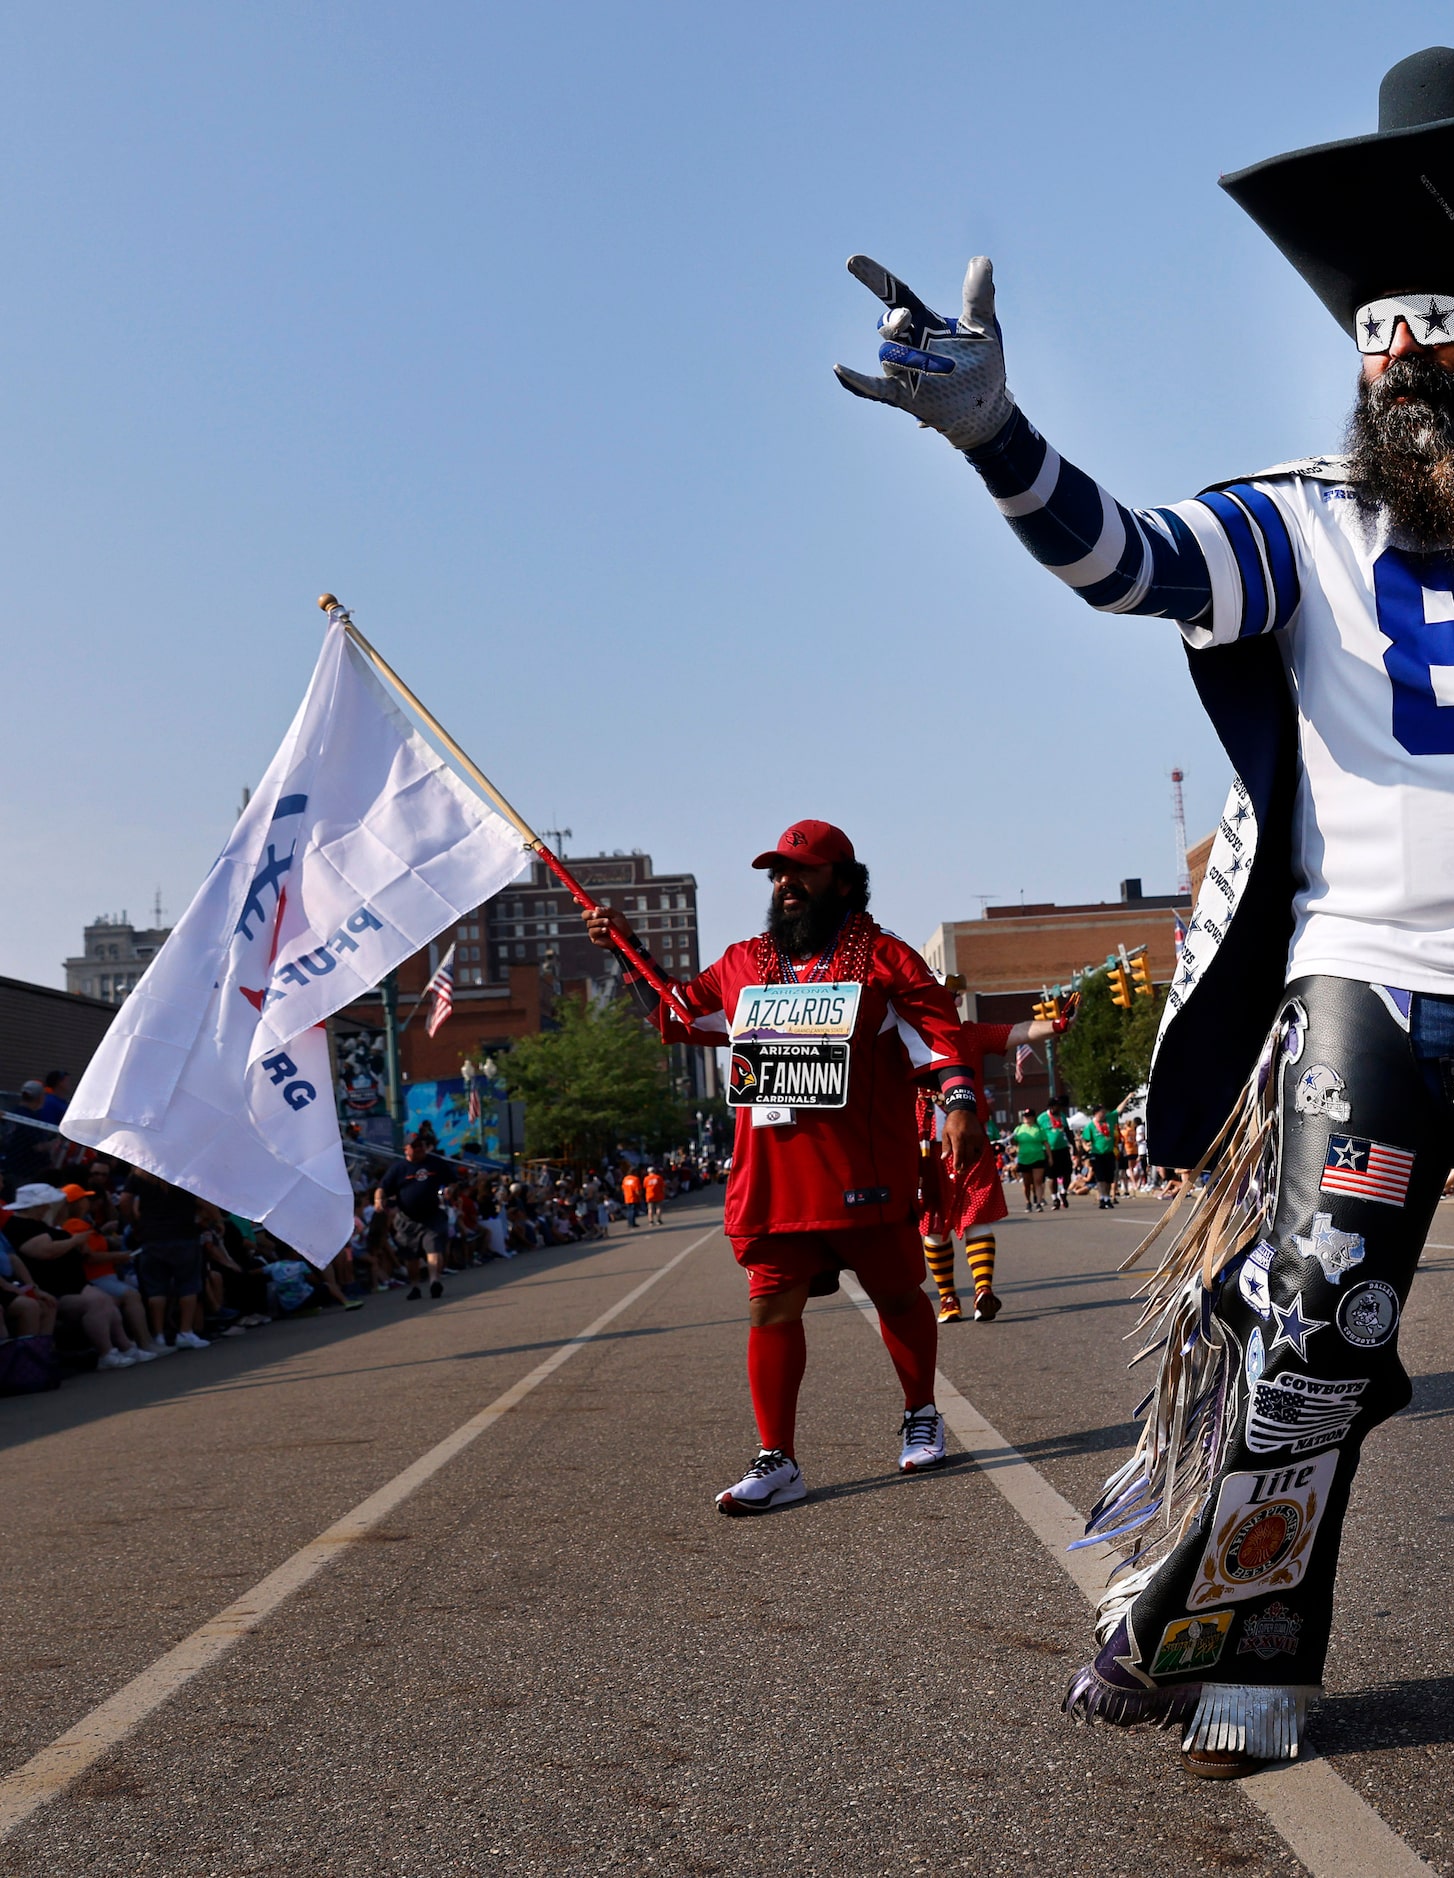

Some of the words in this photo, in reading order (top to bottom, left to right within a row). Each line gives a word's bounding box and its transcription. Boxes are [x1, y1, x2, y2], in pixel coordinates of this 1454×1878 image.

[746, 997, 846, 1027] AZC4RDS
[759, 1046, 820, 1056] ARIZONA
[261, 1049, 317, 1112] RG
[756, 1095, 817, 1104] CARDINALS
[1368, 1282, 1394, 1298] DALLAS
[1343, 1326, 1377, 1345] COWBOYS
[1280, 1375, 1364, 1396] COWBOYS
[1294, 1427, 1345, 1451] NATION
[1246, 1464, 1317, 1504] Lite
[1232, 1513, 1263, 1546] FINE
[1265, 1505, 1297, 1543] PILSNER
[1229, 1545, 1239, 1556] A
[1232, 1560, 1273, 1579] BEER
